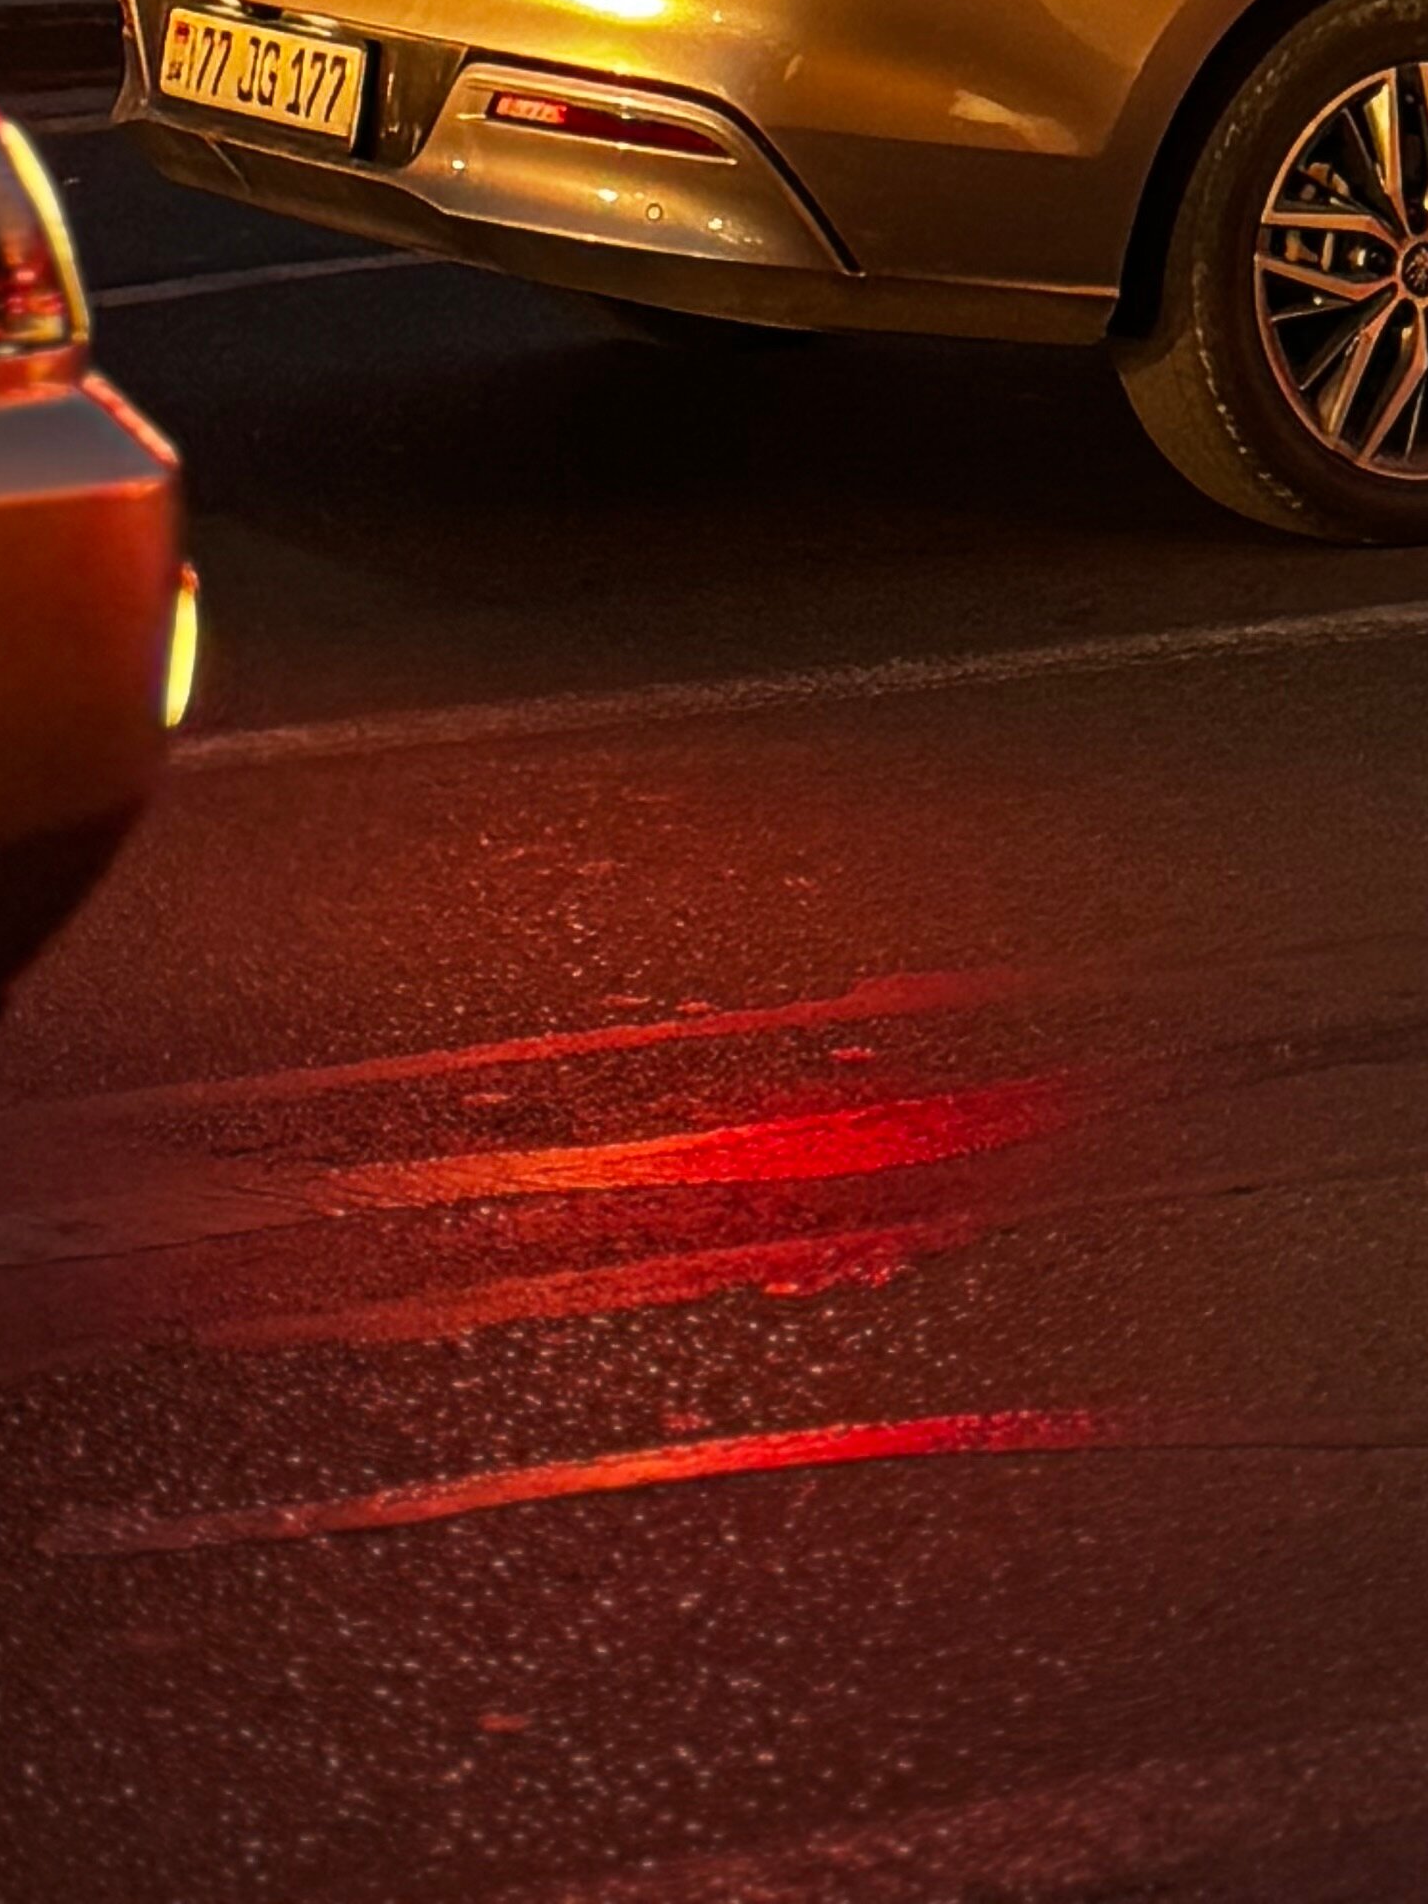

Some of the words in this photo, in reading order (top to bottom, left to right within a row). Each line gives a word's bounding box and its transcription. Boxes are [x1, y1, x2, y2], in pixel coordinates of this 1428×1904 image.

[195, 26, 233, 96] 77
[237, 36, 281, 107] JG
[285, 48, 347, 123] 177
